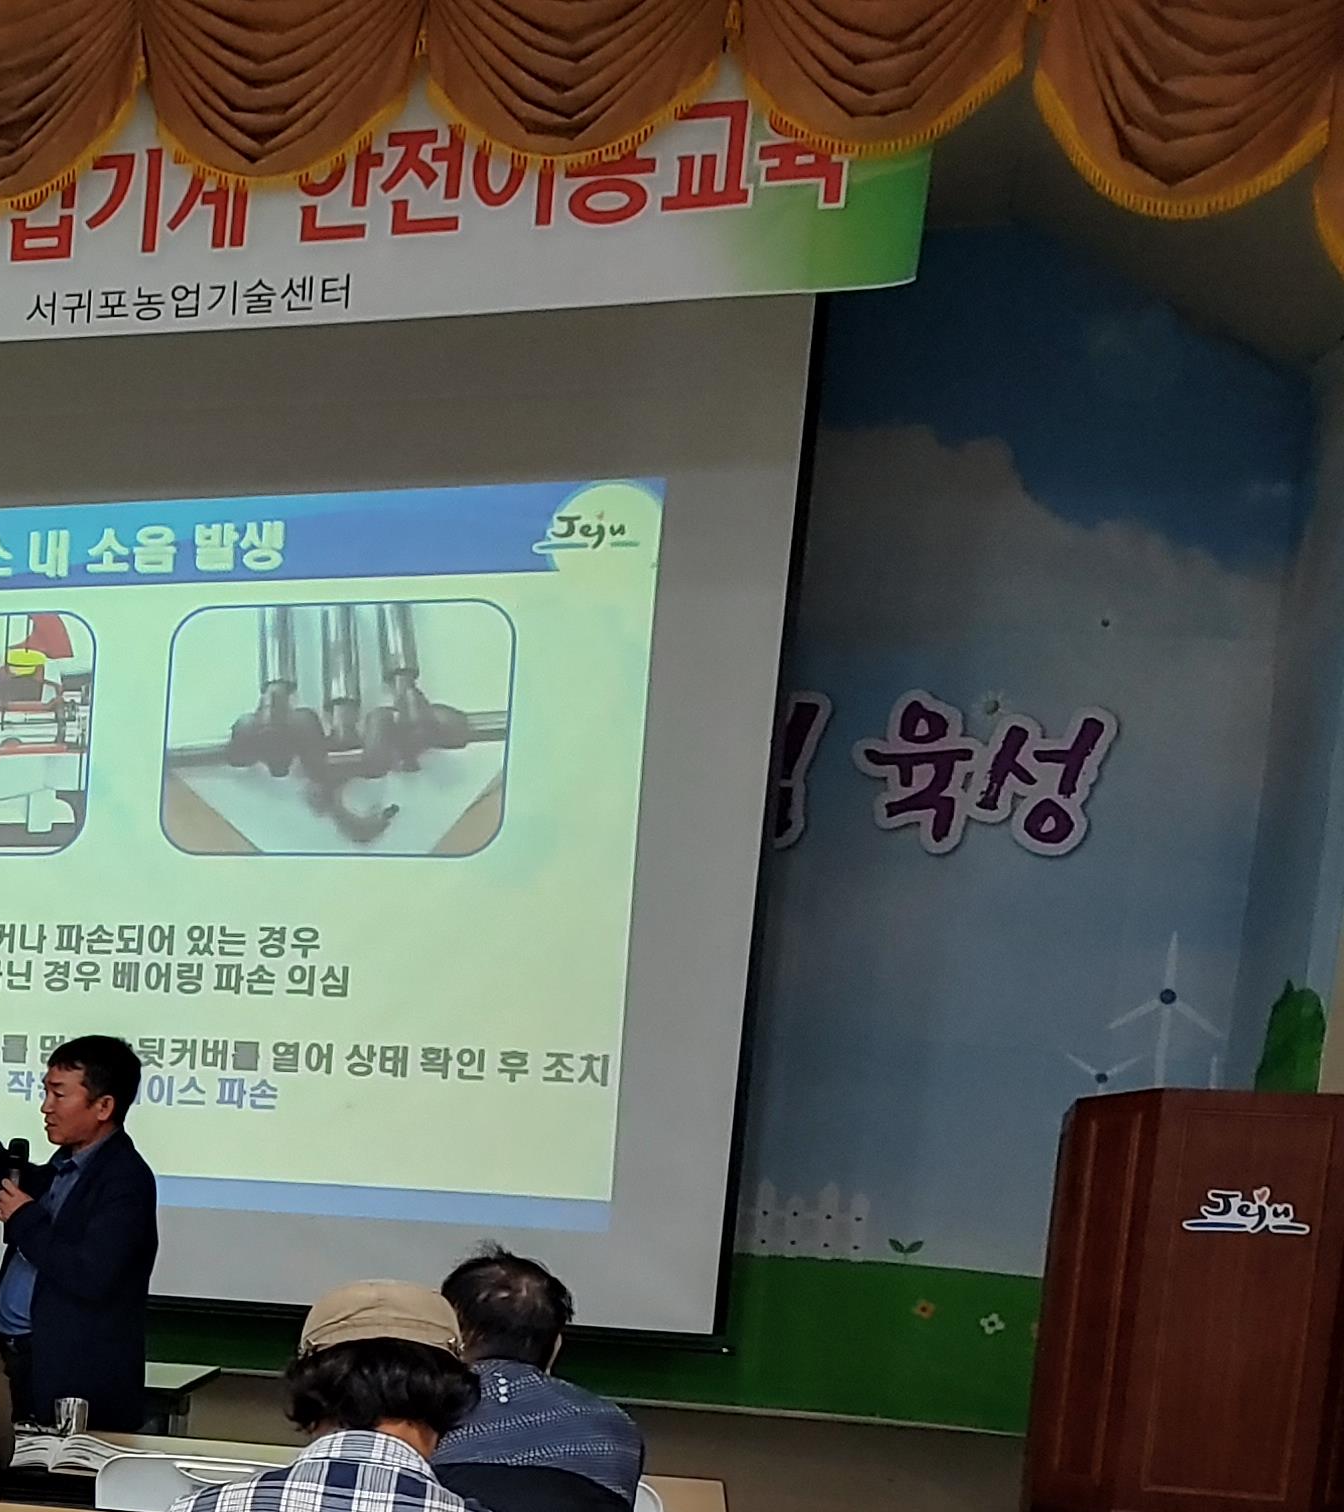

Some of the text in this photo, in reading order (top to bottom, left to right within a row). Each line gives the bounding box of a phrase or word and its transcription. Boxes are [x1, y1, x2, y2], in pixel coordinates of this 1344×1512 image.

[25, 273, 353, 325] 서귀포농업기술센터
[29, 529, 71, 578] 내
[87, 525, 176, 576] 소음
[194, 518, 285, 572] 발생
[551, 511, 626, 550] Jeju
[864, 699, 1106, 845] 육성
[54, 924, 176, 956] 파손되어
[186, 925, 246, 957] 있는
[258, 926, 321, 959] 경우
[43, 960, 101, 993] 경우
[111, 961, 204, 995] 베어링
[213, 963, 275, 996] 파손
[285, 964, 350, 998] 의심
[272, 1041, 334, 1075] 열어
[346, 1044, 409, 1078] 상태
[419, 1046, 486, 1082] 확인
[497, 1049, 530, 1083] 후
[542, 1052, 612, 1088] 조치
[134, 1075, 206, 1107] 이스
[216, 1077, 279, 1110] 파손
[1202, 1189, 1292, 1232] Jeju
